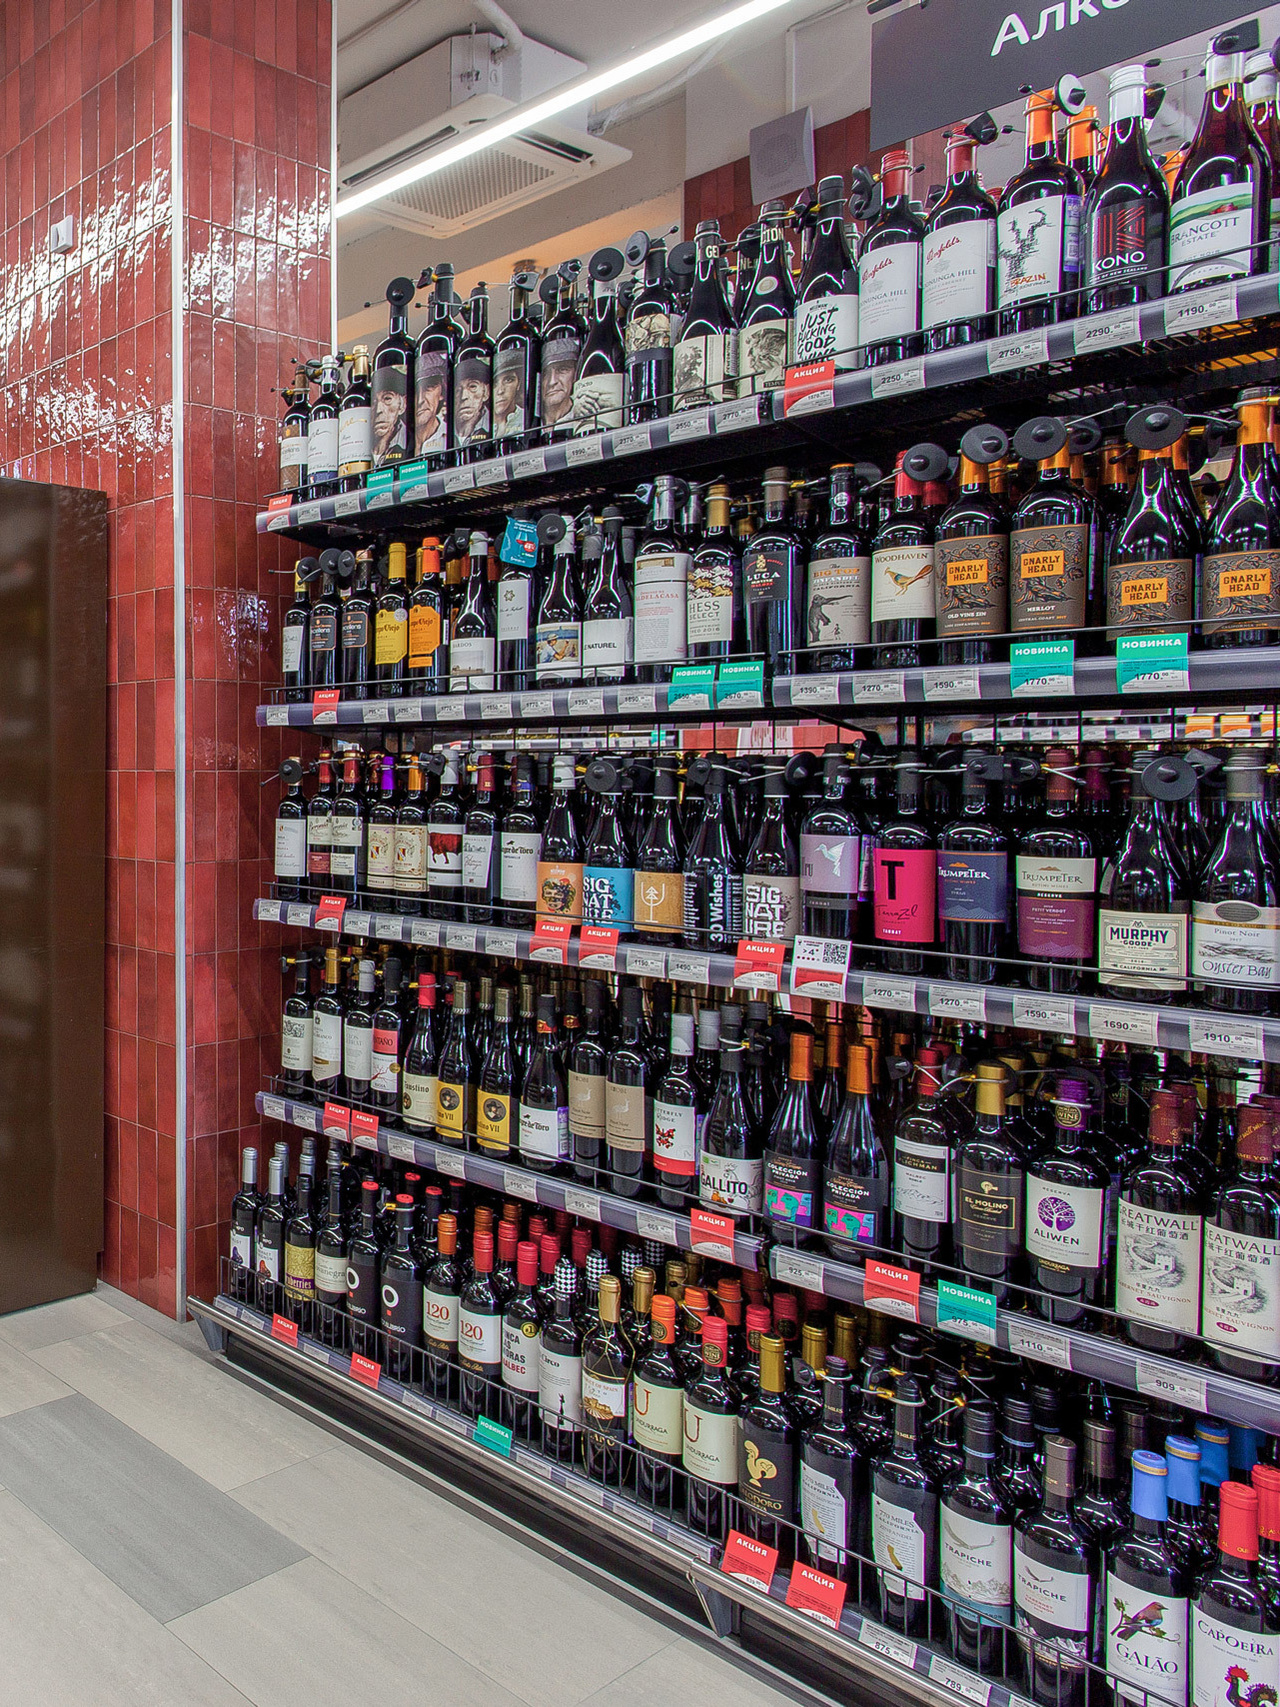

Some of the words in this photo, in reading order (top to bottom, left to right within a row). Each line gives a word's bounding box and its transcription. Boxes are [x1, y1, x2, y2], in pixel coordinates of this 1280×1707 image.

[1171, 217, 1240, 245] BRANCOTT
[1181, 232, 1217, 247] ESTATE
[1095, 250, 1146, 271] KONO
[957, 268, 977, 278] HILL
[1010, 273, 1047, 288] BRAZIN
[890, 289, 908, 297] HILL
[801, 307, 838, 333] JUST
[797, 336, 836, 355] GOOD
[794, 366, 825, 379] АКЦИЯ
[402, 464, 425, 474] НОВИНКА
[369, 472, 392, 482] НОВИНКА
[874, 552, 928, 564] WOODHAVEN
[1022, 554, 1061, 567] GNARLY
[814, 570, 832, 578] BIG
[835, 568, 860, 576] TOP
[948, 562, 985, 575] GNARLY
[1027, 563, 1054, 574] HEAD
[747, 571, 781, 582] LUCA
[952, 571, 979, 581] HEAD
[1223, 573, 1267, 585] GNARLY
[1125, 583, 1164, 593] GNARLY
[1229, 583, 1260, 593] HEAD
[1130, 592, 1157, 601] HEAD
[689, 600, 721, 614] HESS
[689, 611, 720, 621] SELECT
[1122, 639, 1182, 649] НОВИНКА
[1015, 646, 1069, 656] НОВИНКА
[676, 668, 712, 677] НОВИНКА
[722, 665, 761, 674] НОВИНКА
[938, 866, 990, 880] TRUMPETER
[1022, 870, 1083, 884] TRUMPETER
[583, 876, 610, 893] SIG
[881, 860, 905, 900] T
[746, 885, 781, 904] SIG
[746, 902, 785, 920] NAT
[587, 930, 611, 938] АКЦИЯ
[709, 923, 724, 942] 30
[1110, 926, 1169, 944] MURPHY
[1214, 927, 1236, 936] Pinot
[1239, 929, 1261, 938] Noir
[746, 945, 775, 954] АКЦИЯ
[1123, 939, 1152, 947] GOODE
[1120, 964, 1157, 972] CALIFORNIA
[1202, 959, 1246, 976] Oyster
[1247, 964, 1272, 979] Bay
[1057, 1111, 1079, 1120] WINE
[489, 1124, 500, 1133] VII
[772, 1170, 799, 1180] PRIVADA
[701, 1173, 748, 1194] GALLITO
[832, 1189, 860, 1200] PRIVADA
[965, 1196, 973, 1204] EL
[975, 1199, 1008, 1210] MOLINO
[699, 1215, 726, 1227] АКЦИЯ
[1034, 1227, 1080, 1246] ALIWEN
[875, 1266, 908, 1282] АКЦИЯ
[942, 1285, 992, 1306] НОВИНКА
[426, 1301, 450, 1321] 120
[277, 1319, 293, 1329] АКЦИЯ
[460, 1320, 483, 1340] 120
[356, 1358, 375, 1371] АКЦИЯ
[634, 1383, 651, 1416] U
[480, 1420, 509, 1439] НОВИНКА
[684, 1408, 703, 1442] U
[891, 1514, 915, 1528] MILES
[736, 1537, 768, 1557] АКЦИЯ
[944, 1542, 992, 1567] TRAPICHE
[801, 1570, 836, 1590] АКЦИЯ
[1017, 1573, 1066, 1602] TRAPICHE
[1197, 1619, 1274, 1656] CAPOEIRA
[1116, 1642, 1178, 1674] GAIÃO
